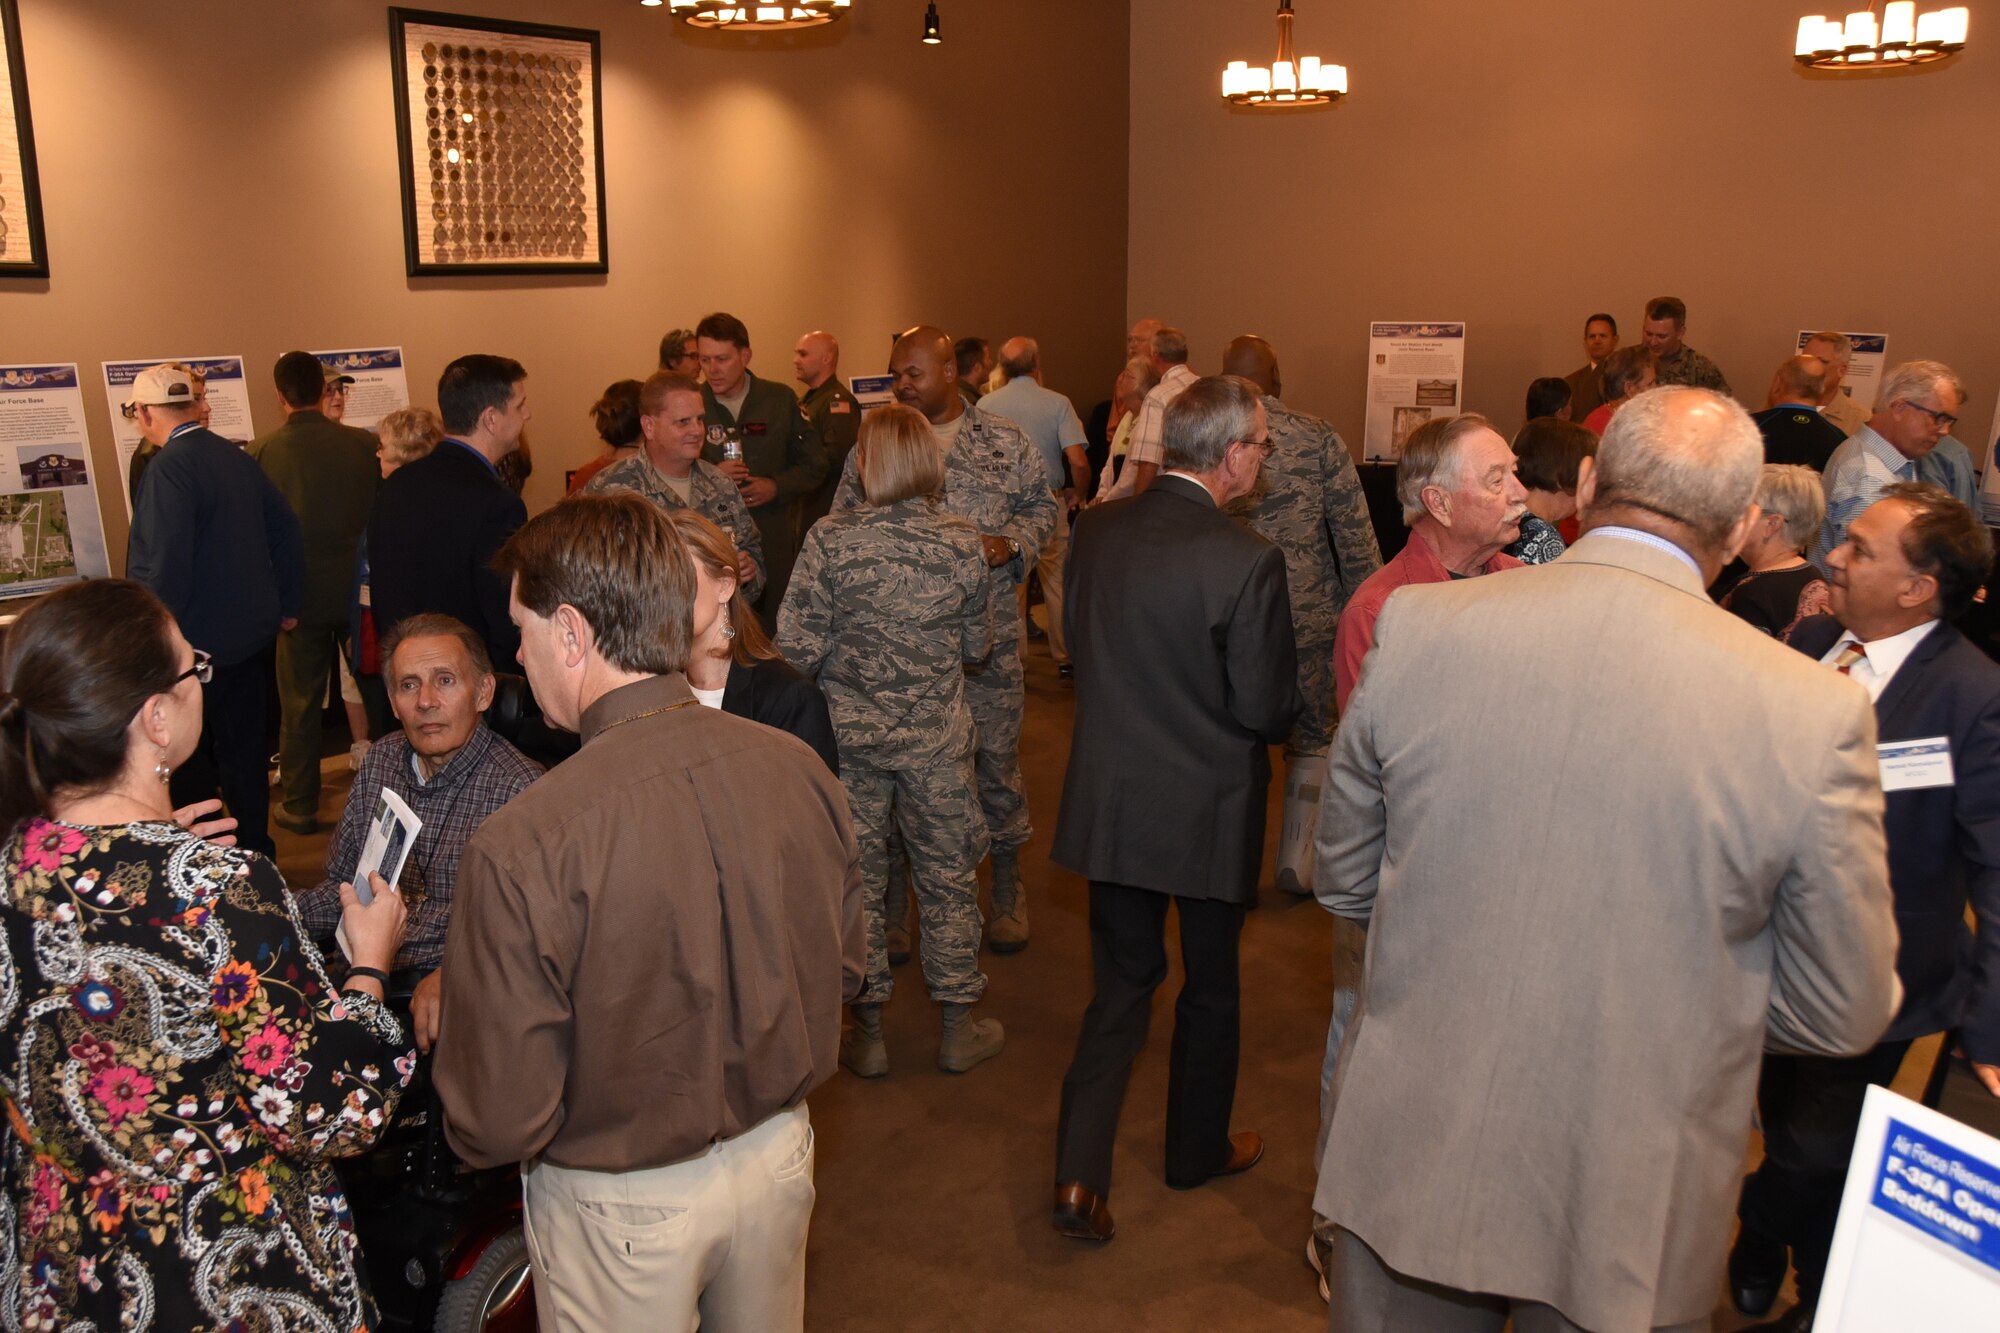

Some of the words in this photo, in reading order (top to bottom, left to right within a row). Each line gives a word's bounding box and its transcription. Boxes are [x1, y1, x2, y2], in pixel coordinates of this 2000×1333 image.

[1886, 1155, 1950, 1203] F-35A
[1911, 1142, 1949, 1176] Force
[1881, 1177, 1982, 1242] Beddown
